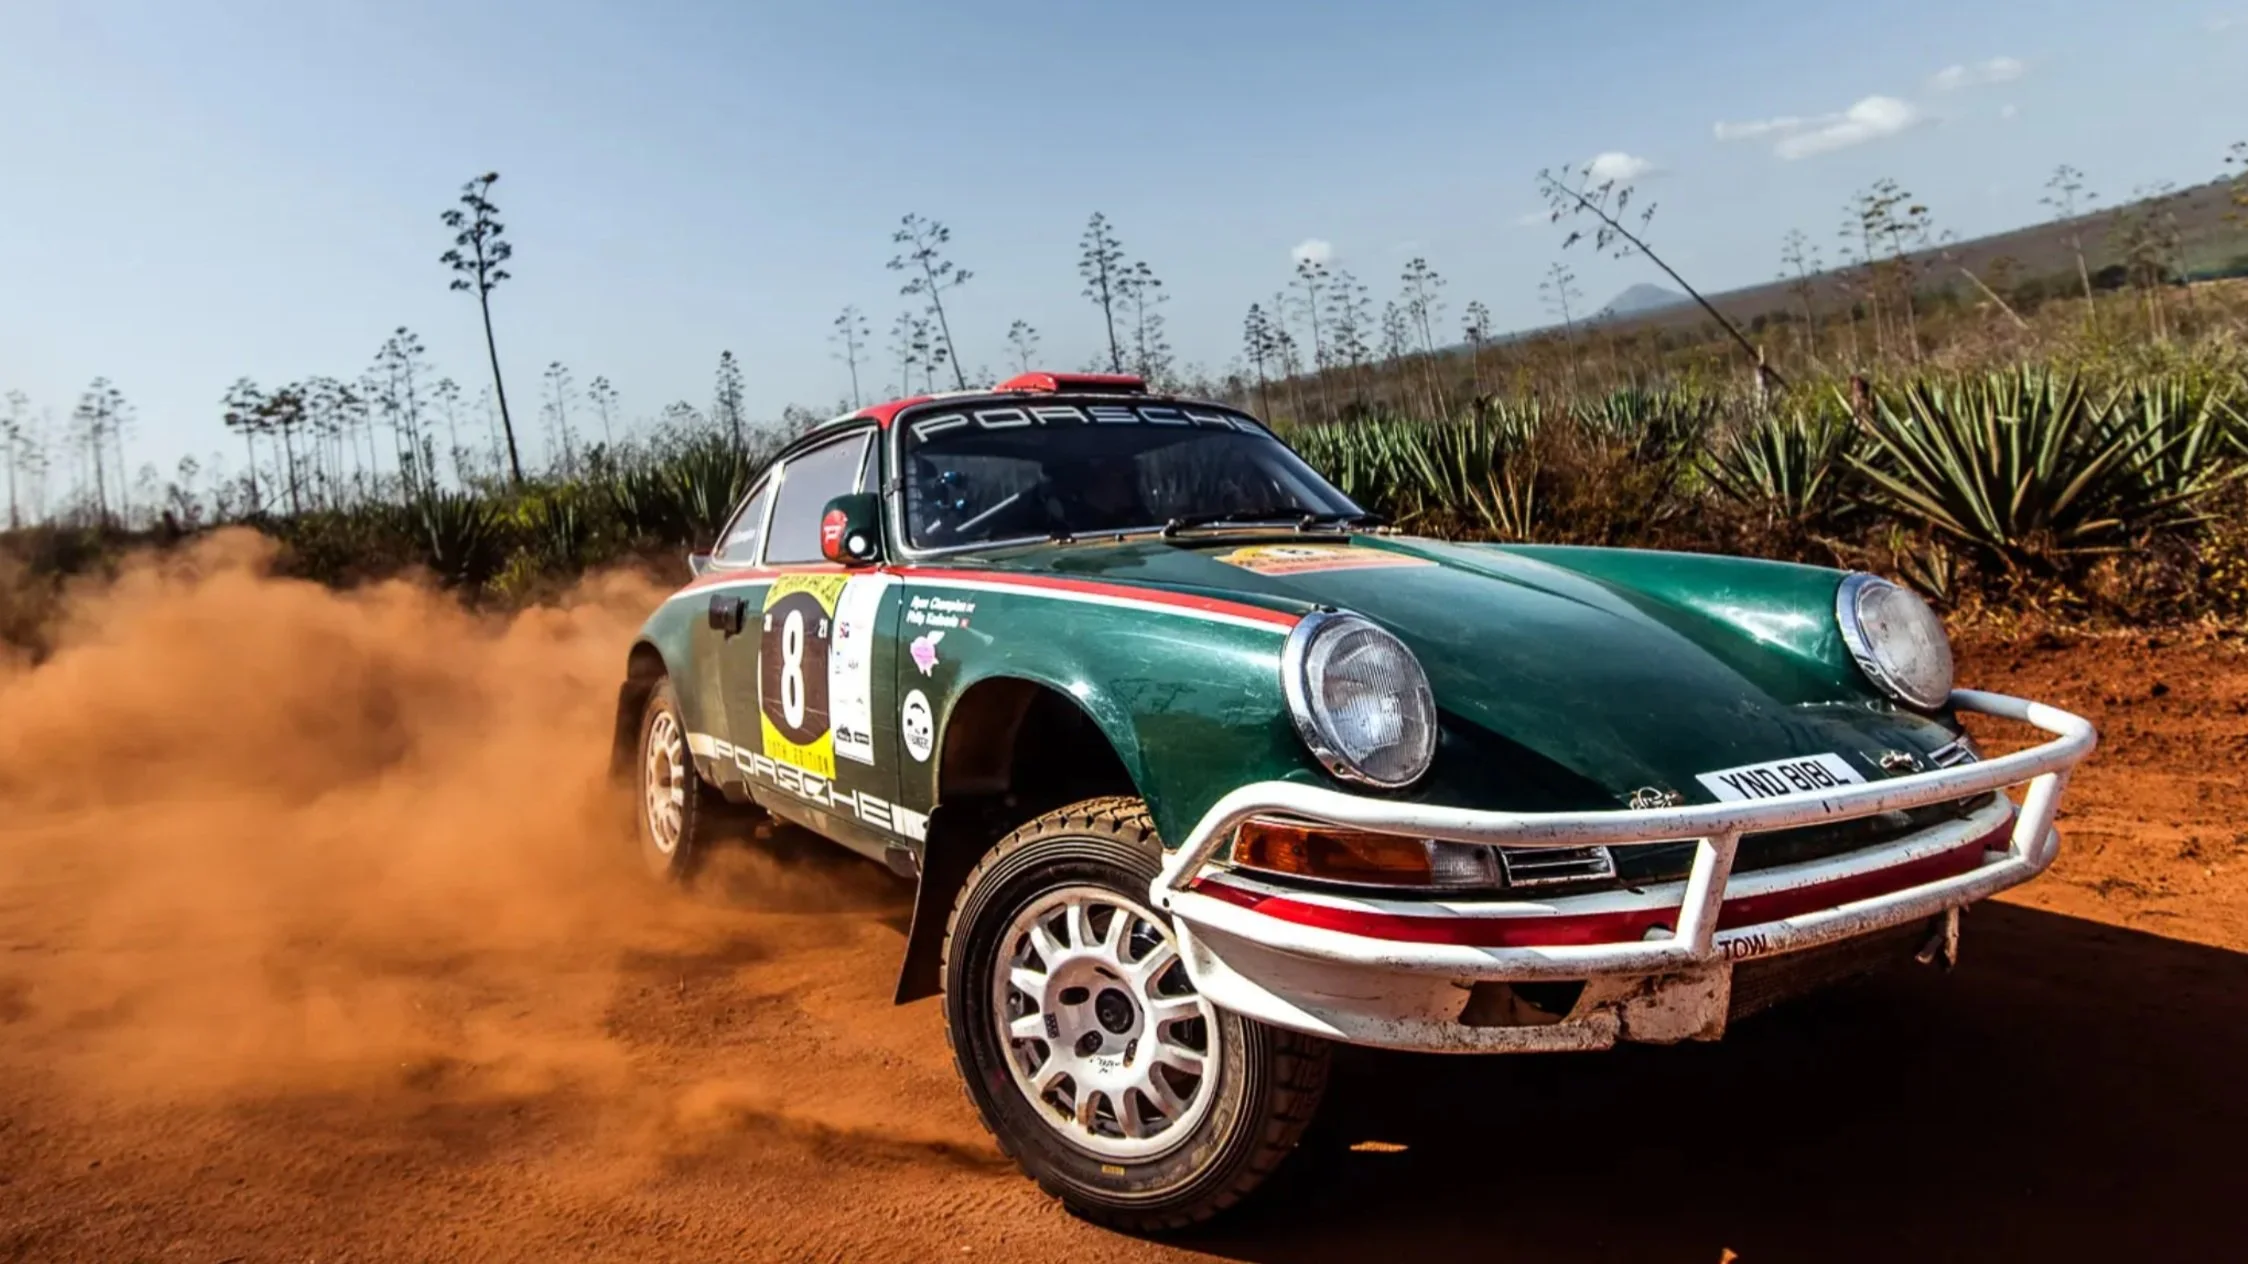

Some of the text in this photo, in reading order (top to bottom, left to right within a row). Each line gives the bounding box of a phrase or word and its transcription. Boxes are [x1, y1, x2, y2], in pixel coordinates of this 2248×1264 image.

[911, 406, 1274, 443] PORSCHE
[781, 609, 804, 729] 8
[715, 737, 893, 831] PORSCHE
[1718, 769, 1791, 800] YND
[1718, 933, 1766, 960] TOW
